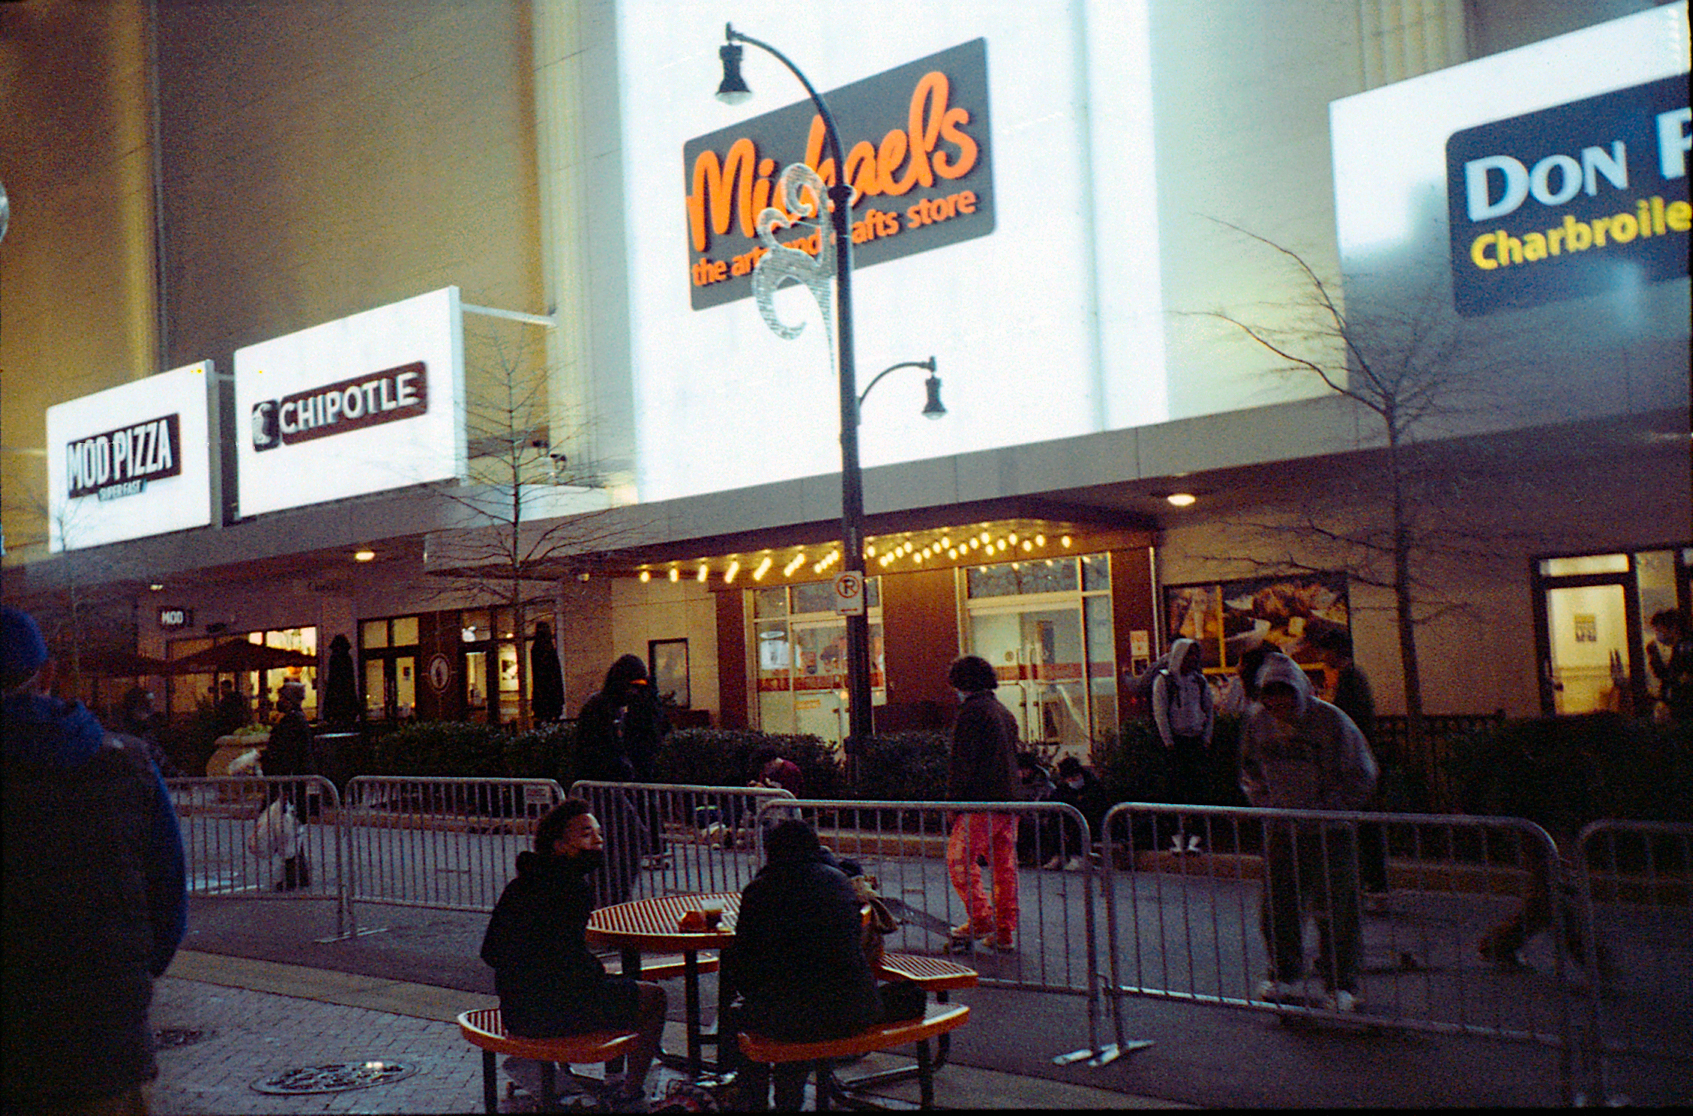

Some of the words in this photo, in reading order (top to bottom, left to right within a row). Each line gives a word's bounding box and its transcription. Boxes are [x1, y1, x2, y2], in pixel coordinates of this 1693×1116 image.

[1465, 139, 1629, 222] DON
[692, 257, 727, 286] the
[731, 246, 770, 276] art
[830, 208, 900, 246] afts
[907, 190, 976, 228] store
[1470, 195, 1692, 270] Charbroile
[279, 371, 420, 434] CHIPOTLE
[67, 436, 110, 490] MOD
[113, 419, 172, 481] PIZZA
[161, 611, 183, 625] MOD
